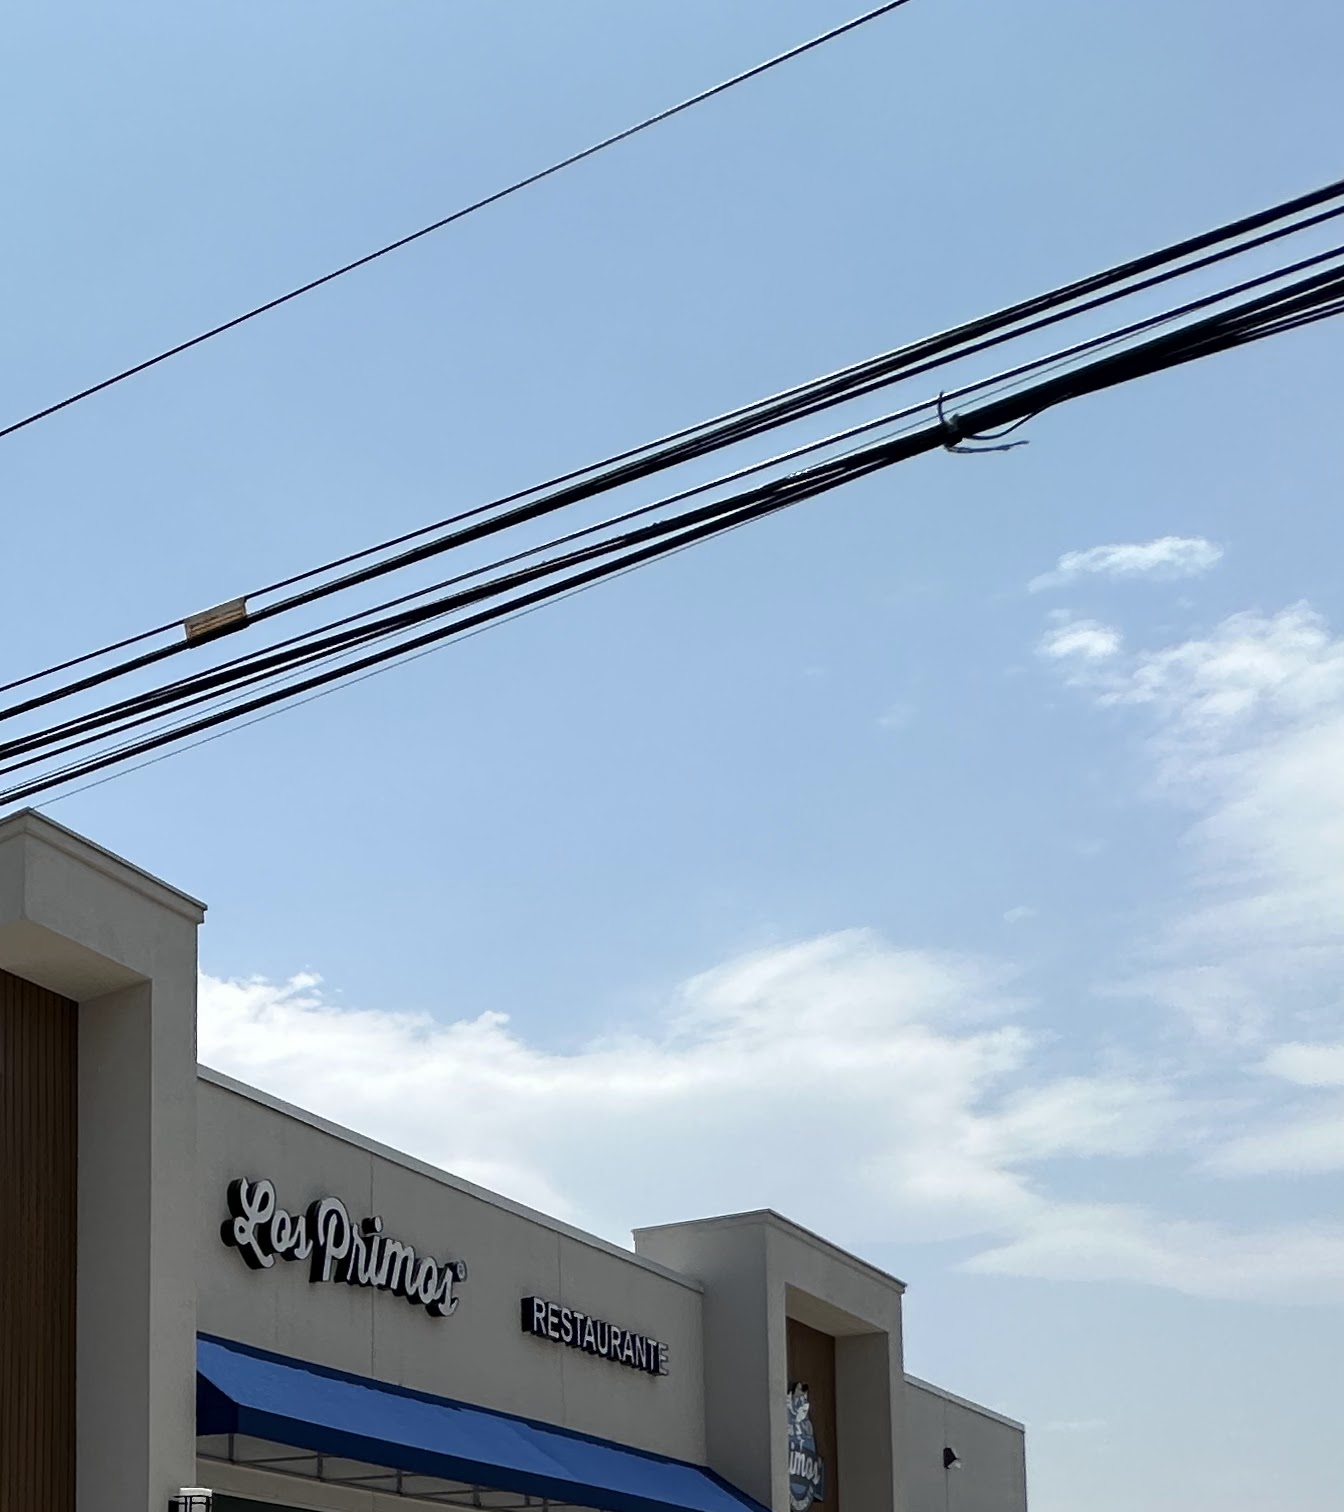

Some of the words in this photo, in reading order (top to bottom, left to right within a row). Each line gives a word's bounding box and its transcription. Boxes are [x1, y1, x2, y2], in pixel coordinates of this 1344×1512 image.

[232, 1177, 313, 1268] Los
[531, 1296, 669, 1376] RESTAURANTE
[790, 1441, 821, 1485] imos
